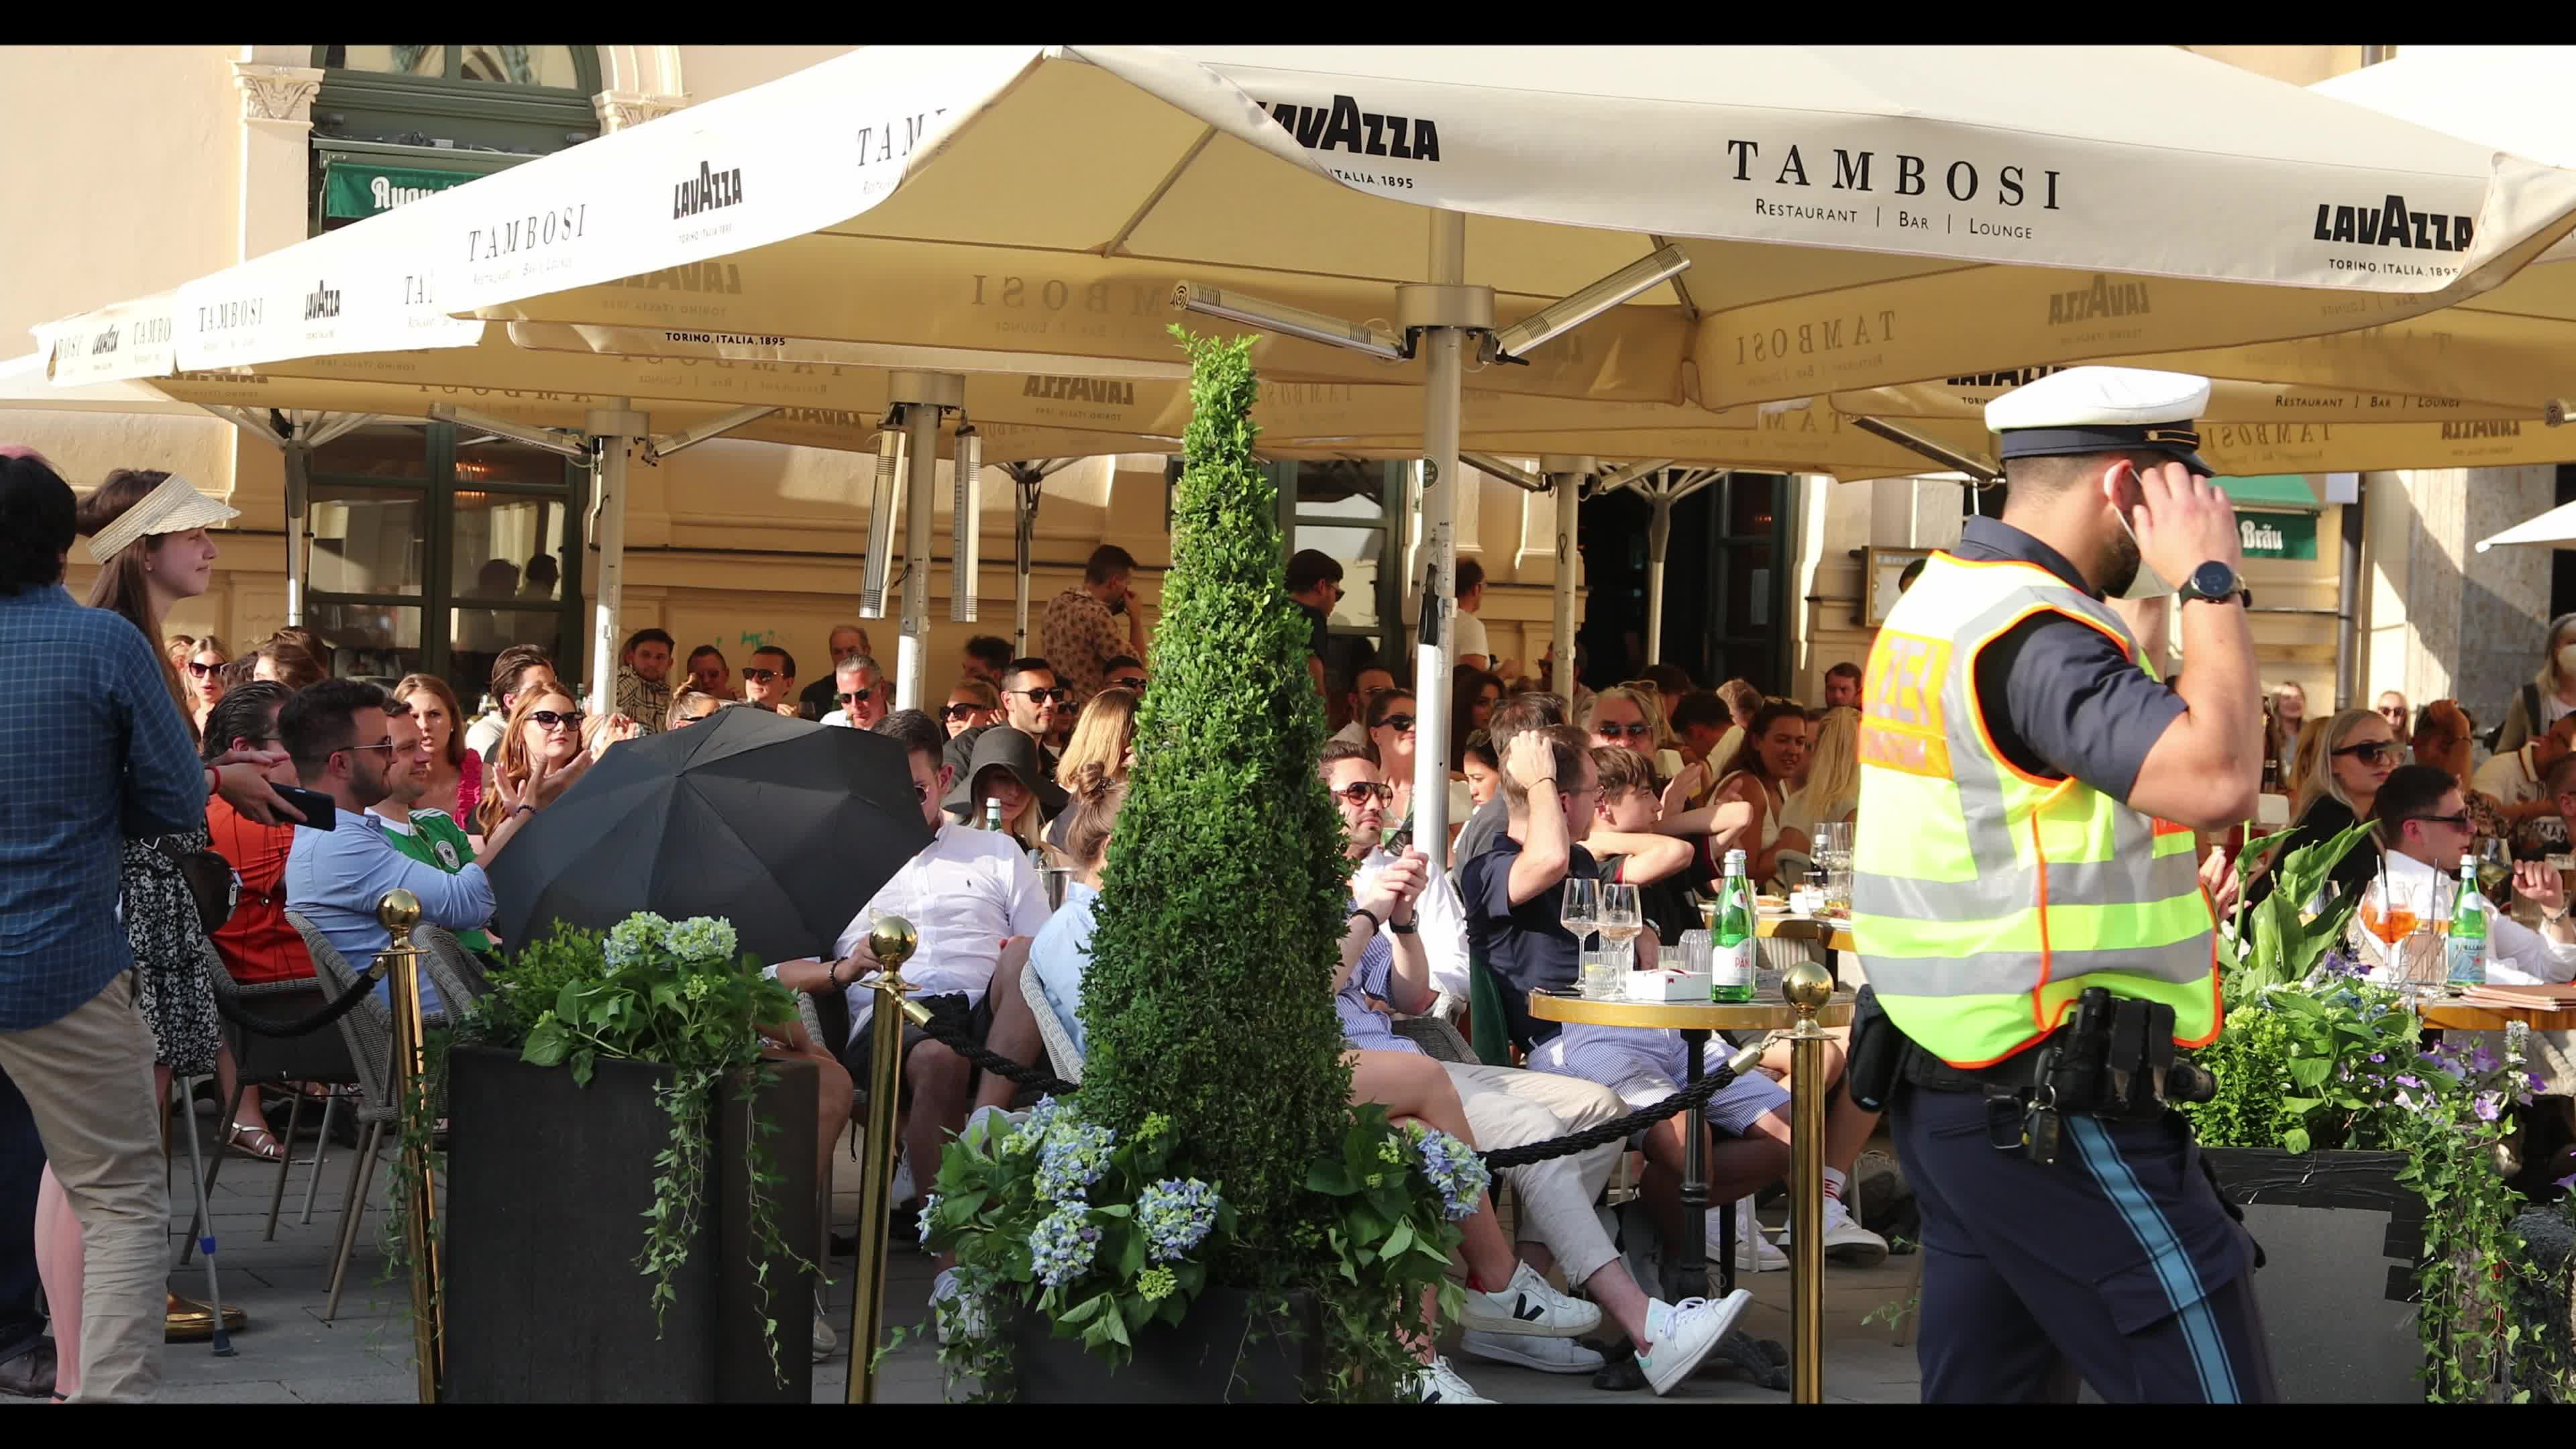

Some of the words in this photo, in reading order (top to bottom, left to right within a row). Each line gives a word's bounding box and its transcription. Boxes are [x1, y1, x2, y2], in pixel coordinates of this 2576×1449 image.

[857, 109, 947, 166] TAM
[1254, 95, 1440, 162] AVAZZA
[673, 160, 743, 220] LAVAZZA
[1381, 176, 1413, 189] 1895
[1728, 140, 2060, 209] TAMBOSI
[467, 204, 586, 262] TAMBOSI
[1756, 199, 1858, 223] RESTAURANT
[1900, 211, 1929, 230] BAR
[1970, 218, 2033, 239] LOUNGE
[2275, 394, 2345, 409] RESTAURANT
[2369, 395, 2392, 409] BAR
[2241, 520, 2283, 550] Bräu
